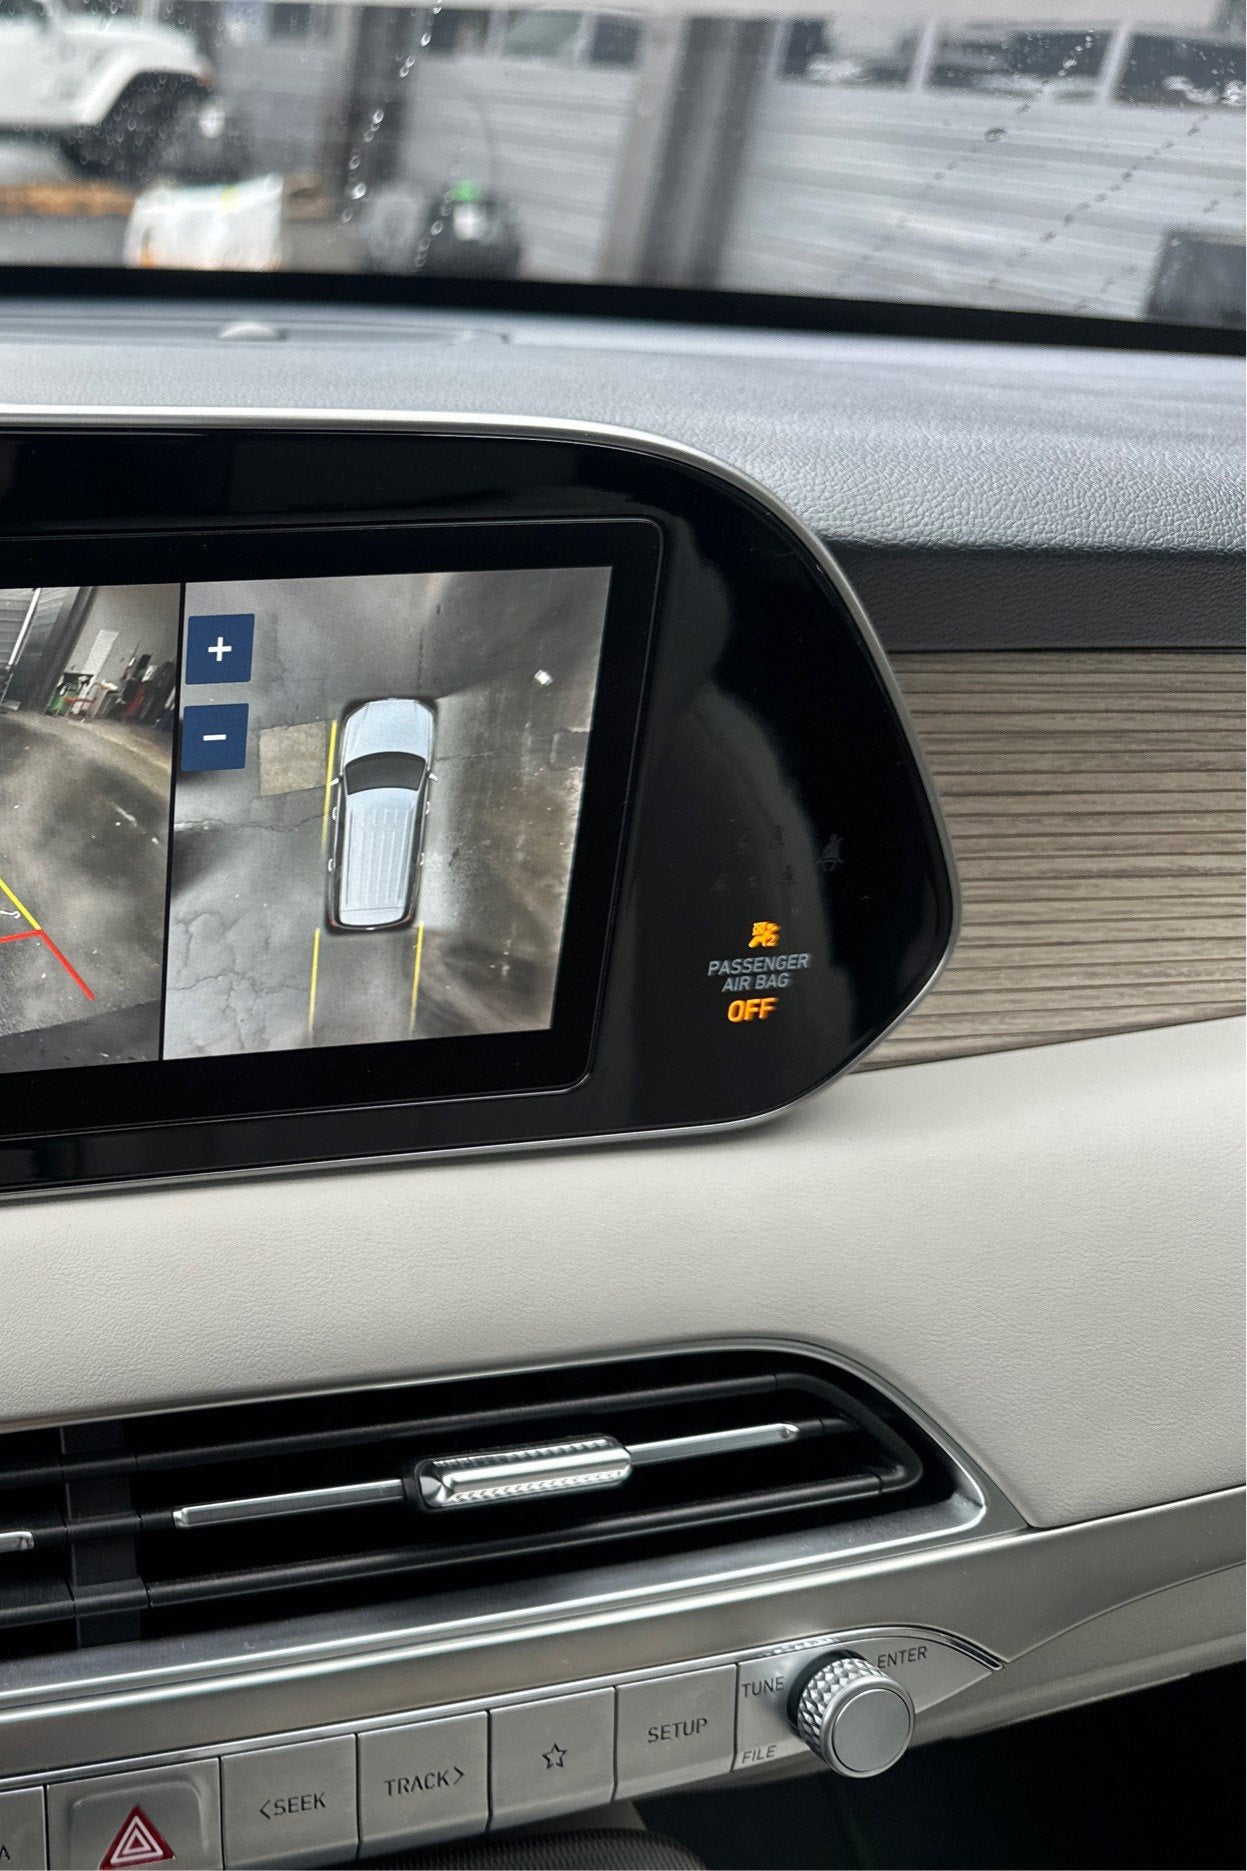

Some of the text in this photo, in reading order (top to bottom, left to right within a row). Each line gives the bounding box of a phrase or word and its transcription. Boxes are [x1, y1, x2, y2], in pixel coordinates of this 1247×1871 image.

[707, 953, 812, 976] PASSENGER
[721, 973, 791, 992] AIR BAG
[727, 997, 779, 1023] OFF
[877, 1646, 928, 1669] ENTER
[741, 1676, 784, 1698] TUNE
[647, 1717, 708, 1743] SETUP
[741, 1745, 777, 1764] FILE
